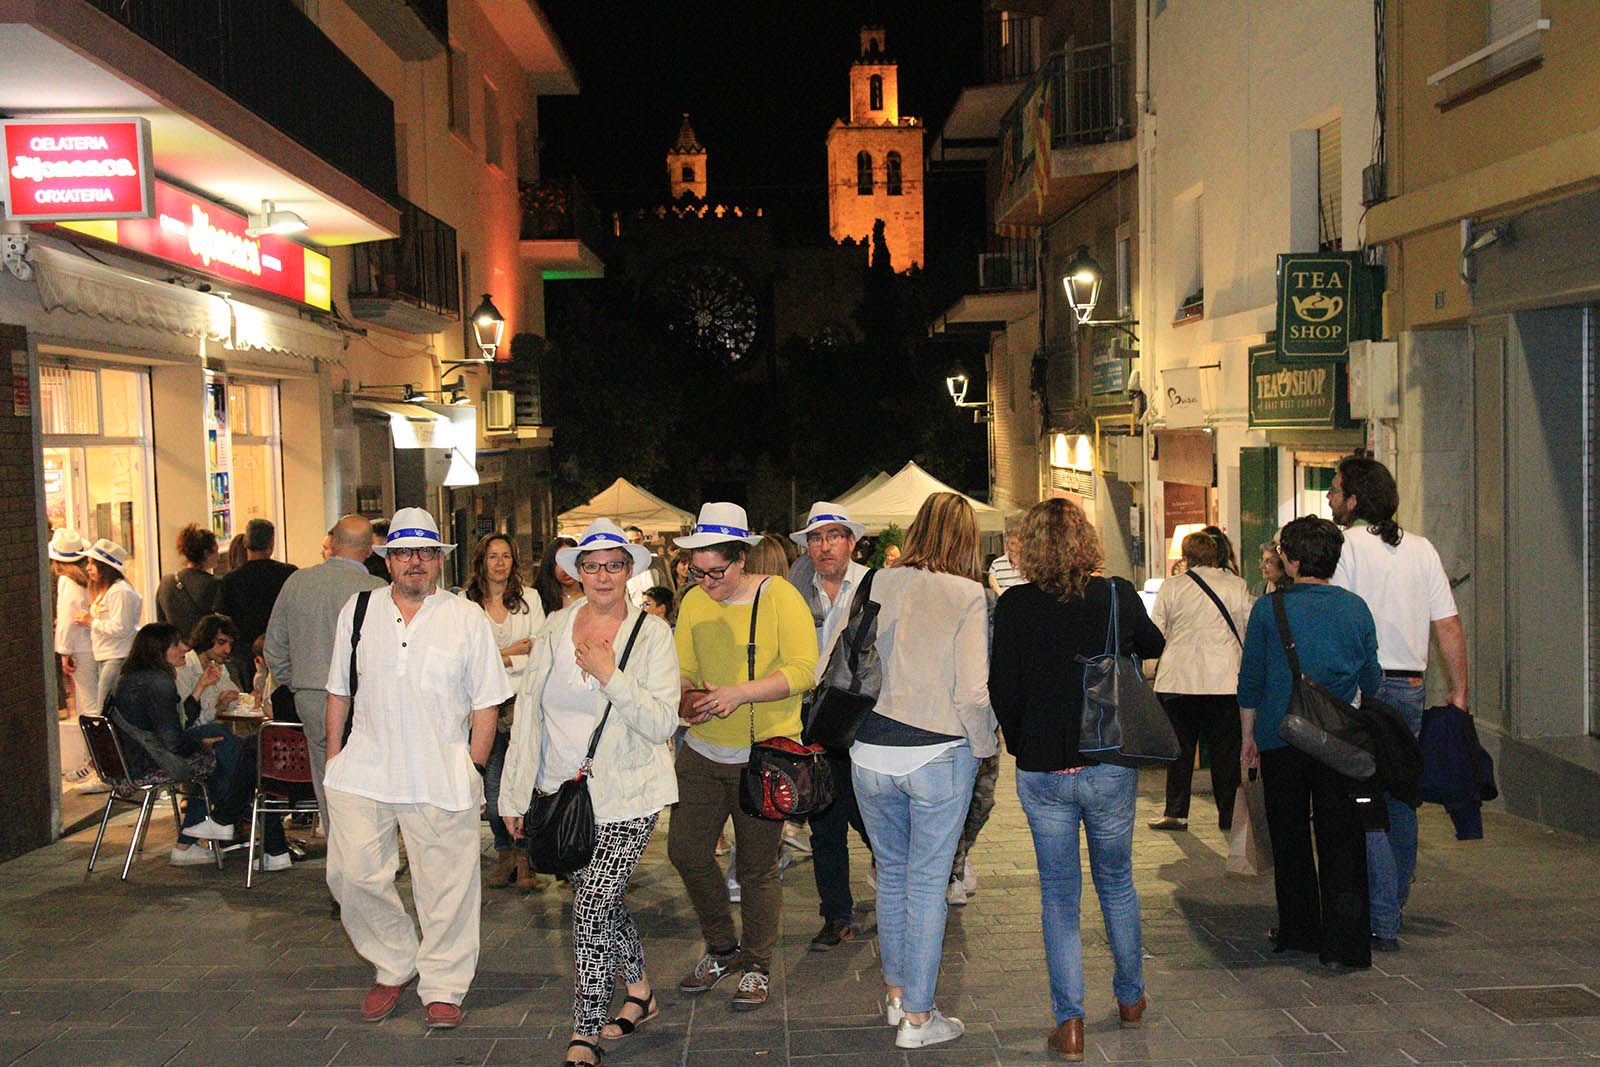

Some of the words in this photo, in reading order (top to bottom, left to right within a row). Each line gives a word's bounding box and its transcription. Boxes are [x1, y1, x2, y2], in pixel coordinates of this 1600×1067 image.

[30, 136, 109, 151] GELATERIA
[35, 188, 114, 203] ORXATERIA
[1292, 272, 1344, 289] TEA
[1290, 325, 1342, 339] SHOP
[1256, 373, 1279, 399] TEA
[1292, 368, 1327, 396] SHOP
